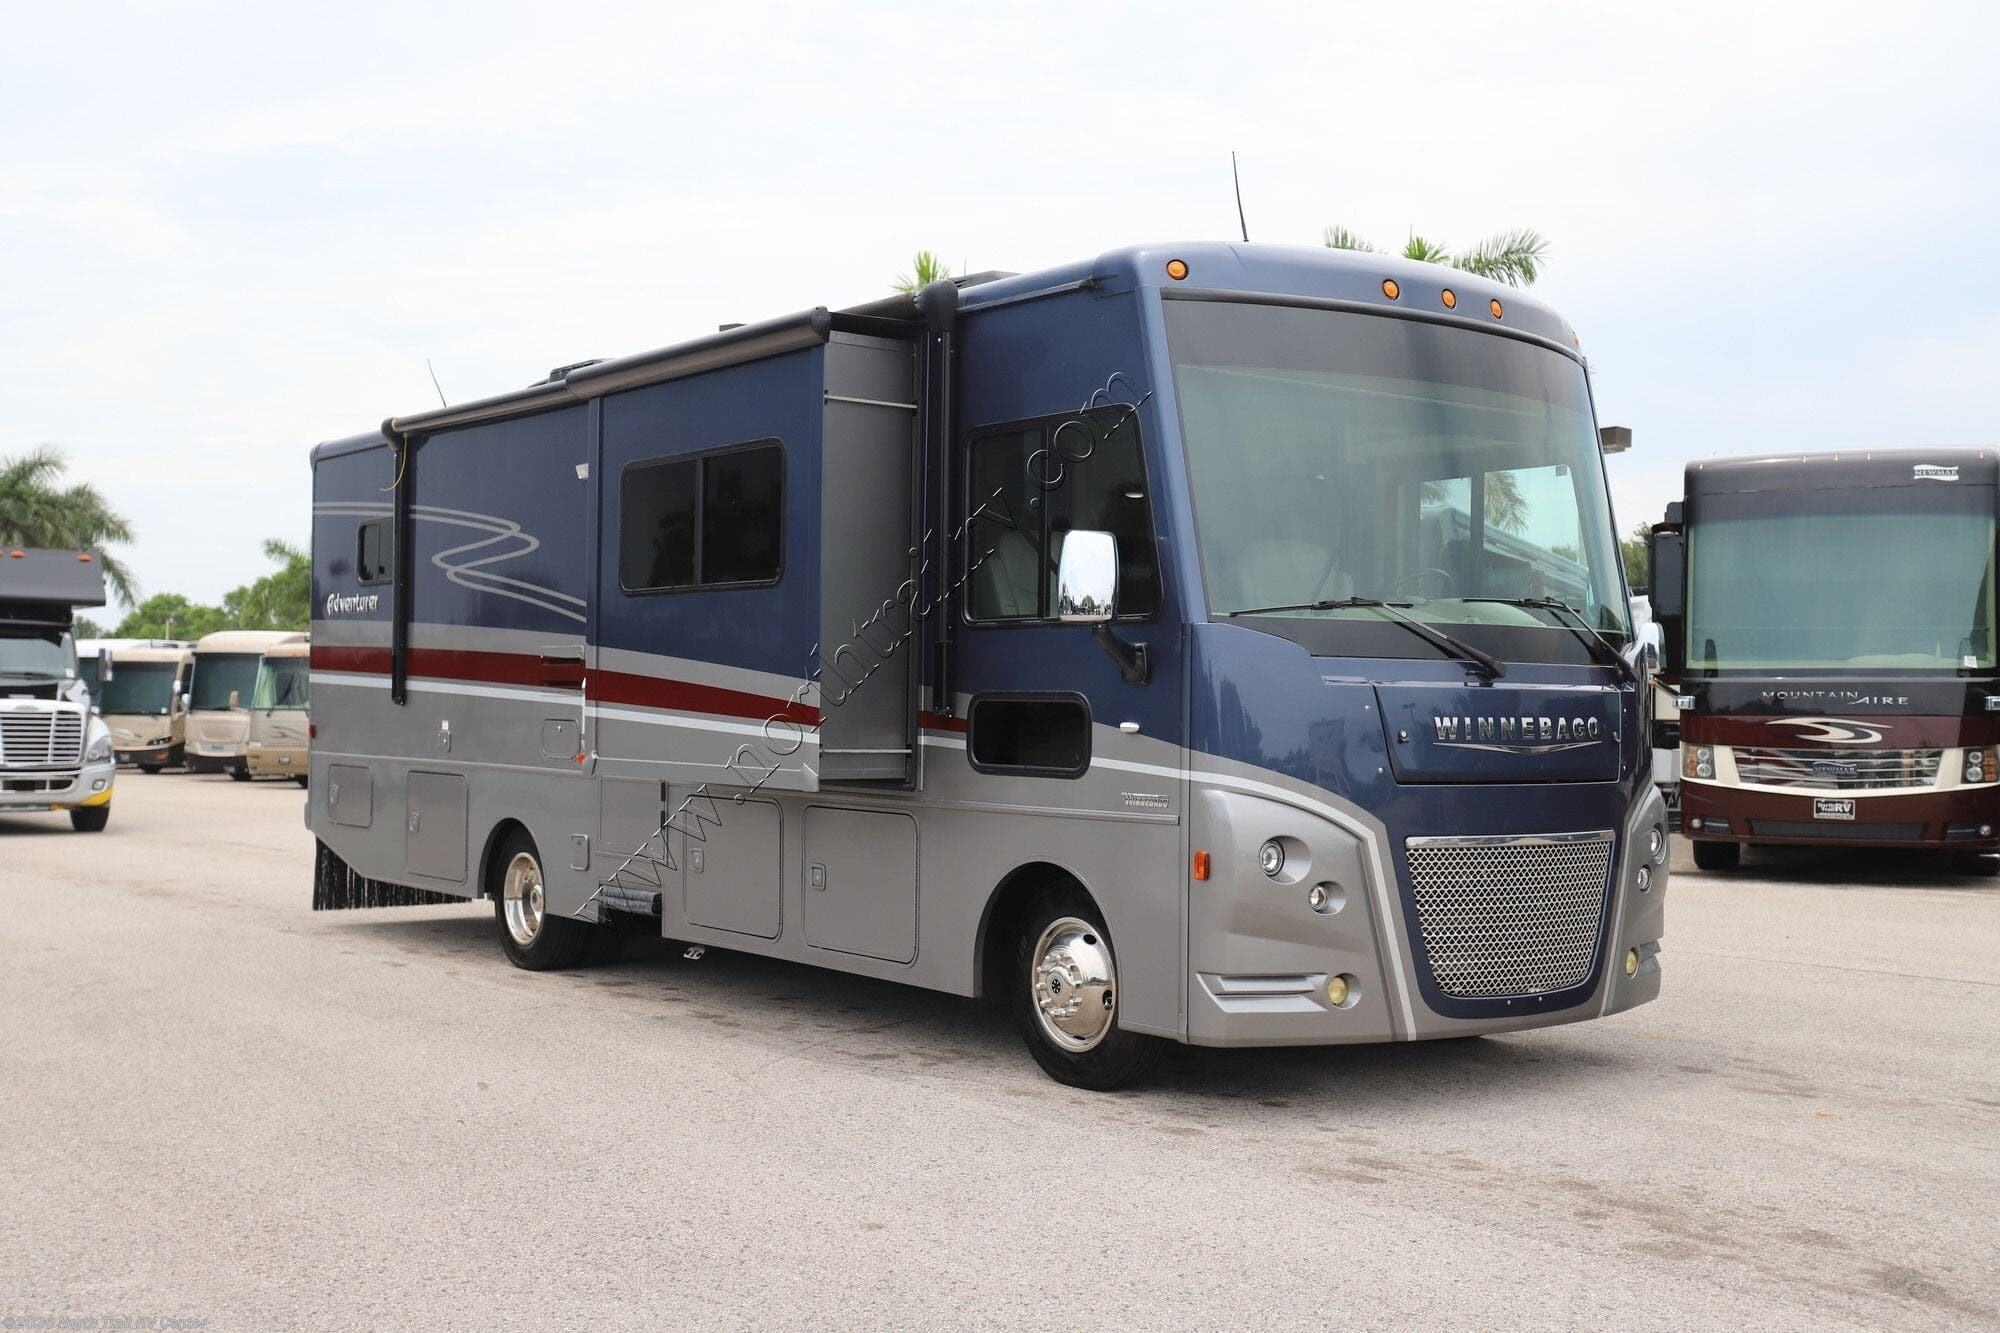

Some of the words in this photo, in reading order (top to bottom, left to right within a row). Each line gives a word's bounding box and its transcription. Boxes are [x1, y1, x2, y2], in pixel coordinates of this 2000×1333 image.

[327, 592, 379, 616] Adventurer
[1761, 690, 1859, 699] MOUNTAIN
[1847, 696, 1909, 705] AIRE
[1433, 716, 1599, 741] WINNEBAGO
[1835, 802, 1852, 812] RV
